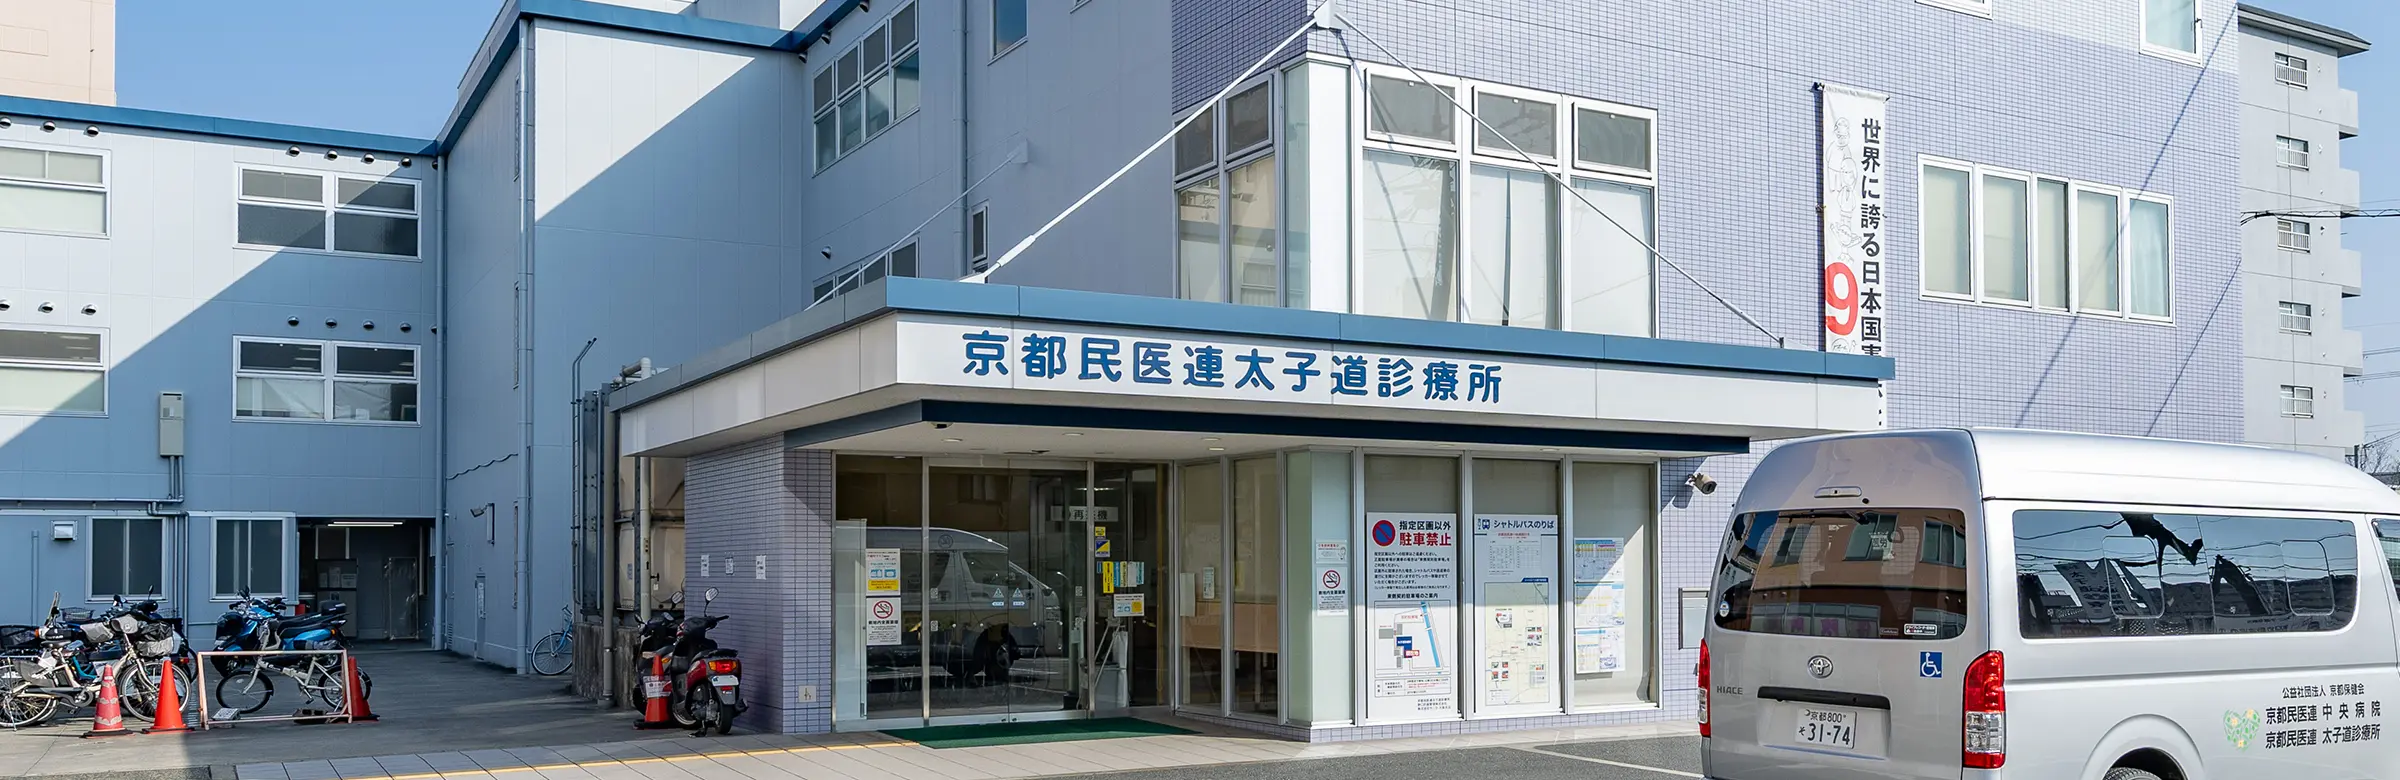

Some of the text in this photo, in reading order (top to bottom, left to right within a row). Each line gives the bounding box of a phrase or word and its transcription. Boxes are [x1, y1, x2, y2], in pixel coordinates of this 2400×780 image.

[1825, 262, 1859, 336] 9
[962, 330, 1503, 404] 京都民医連太子道診療所
[1399, 520, 1451, 531] 指定区画以外
[1493, 519, 1555, 530] シャトルバスのりば
[1399, 532, 1452, 547] 駐車禁止
[1716, 686, 1743, 695] HIACE
[2282, 683, 2365, 699] 公益社団法人 京都保健会
[2265, 704, 2318, 725] 京都民医連
[1807, 722, 1851, 745] 31-74
[2265, 723, 2381, 749] 京都民医連 太子道診療所
